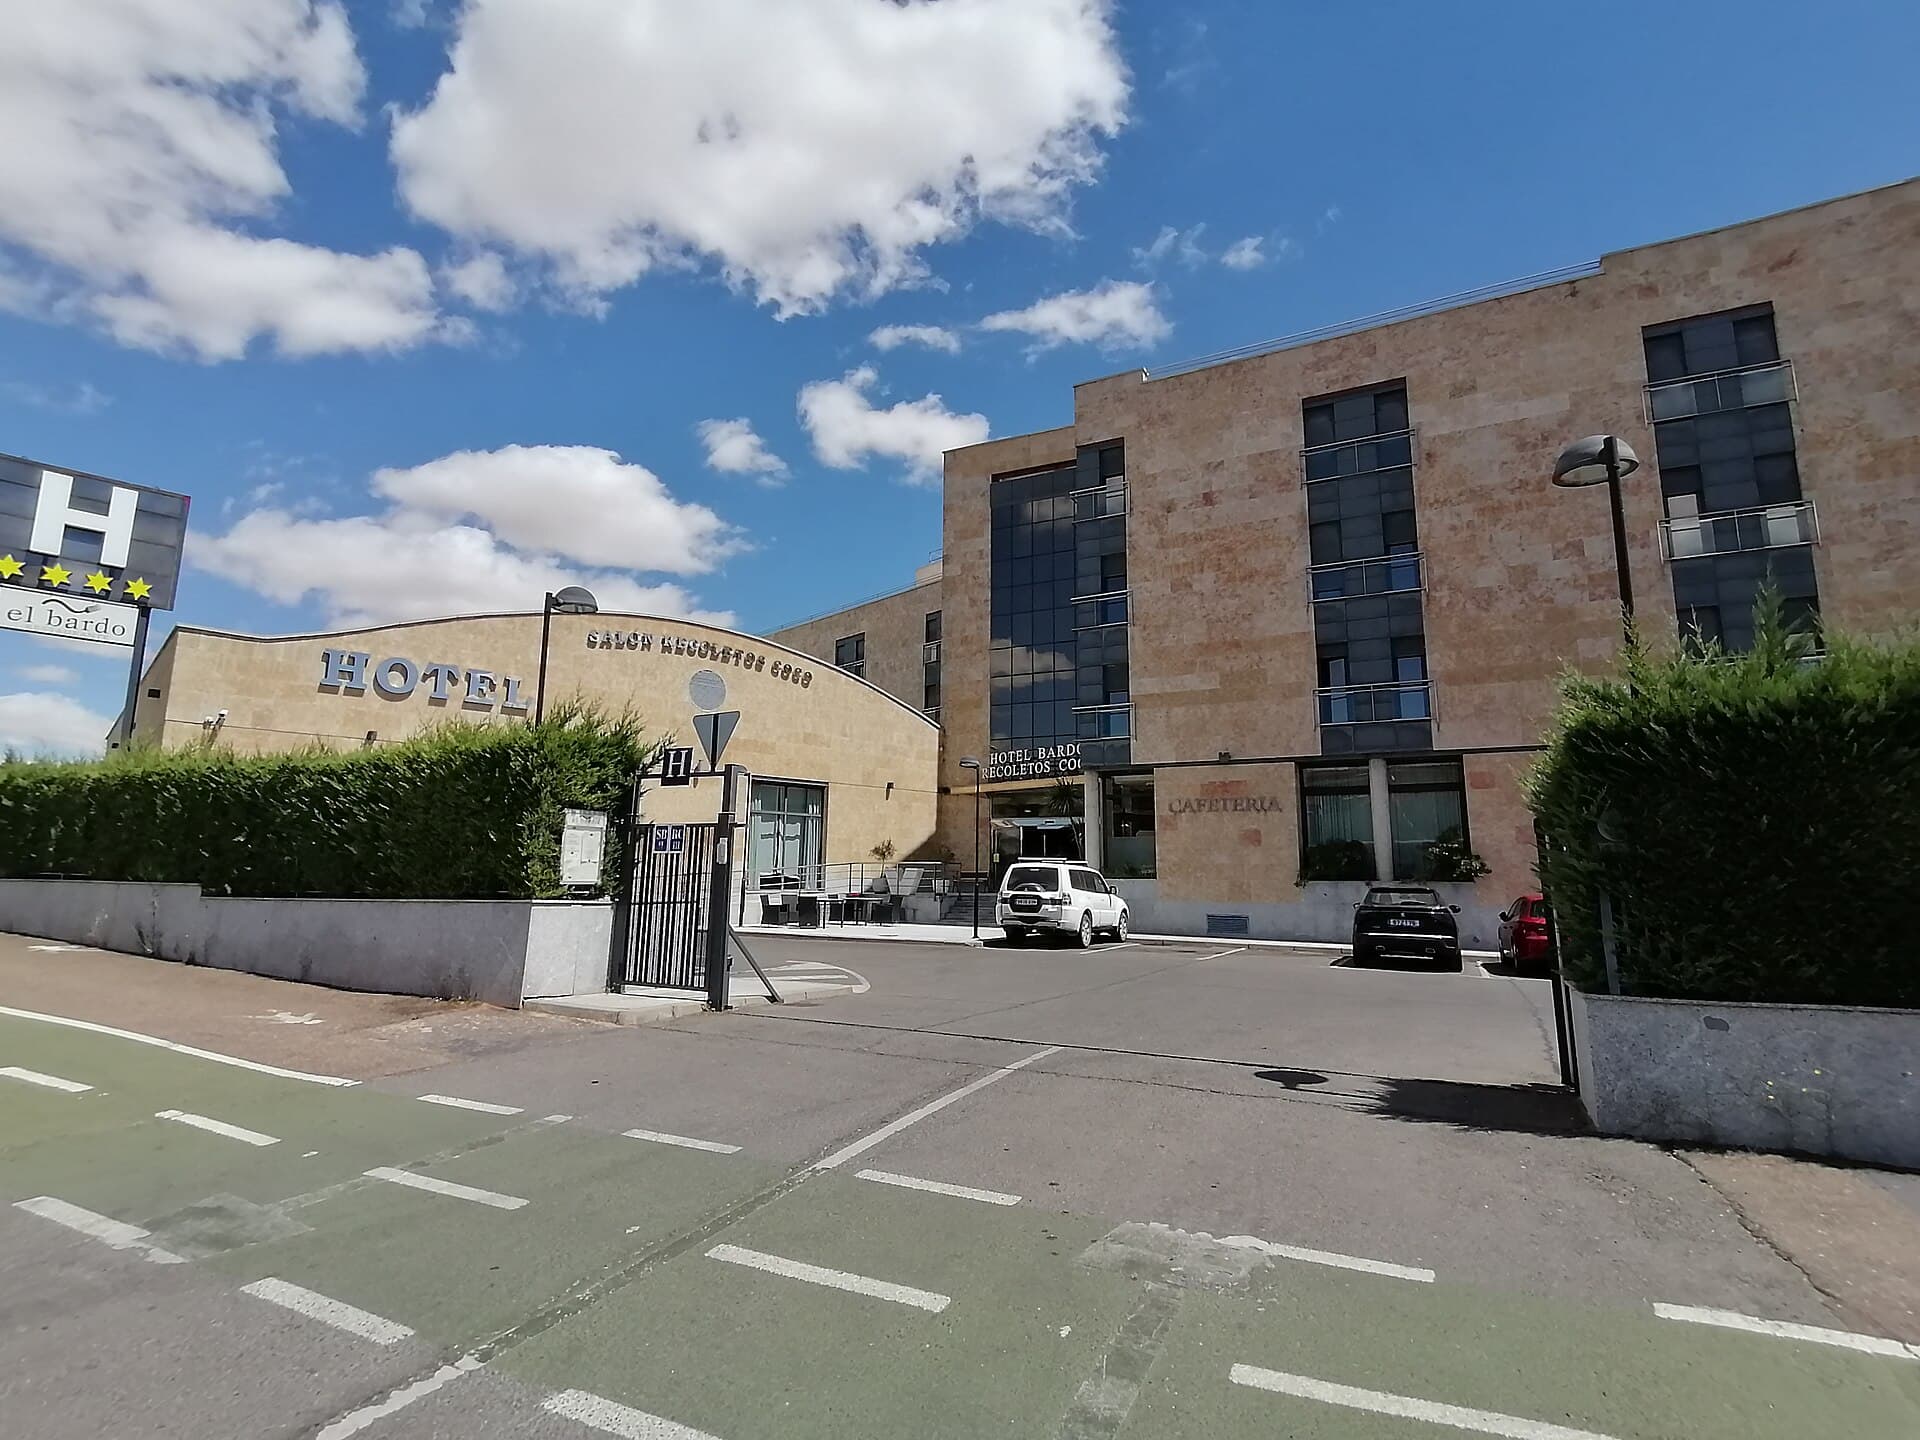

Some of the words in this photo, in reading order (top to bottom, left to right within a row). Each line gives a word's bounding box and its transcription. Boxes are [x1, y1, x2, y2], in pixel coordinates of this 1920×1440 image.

[28, 470, 139, 568] H
[7, 606, 33, 622] el
[47, 609, 126, 637] bardo
[319, 648, 535, 714] HOTEL
[666, 751, 688, 778] H
[982, 761, 1051, 779] RECOLETOS
[989, 749, 1033, 765] HOTEL
